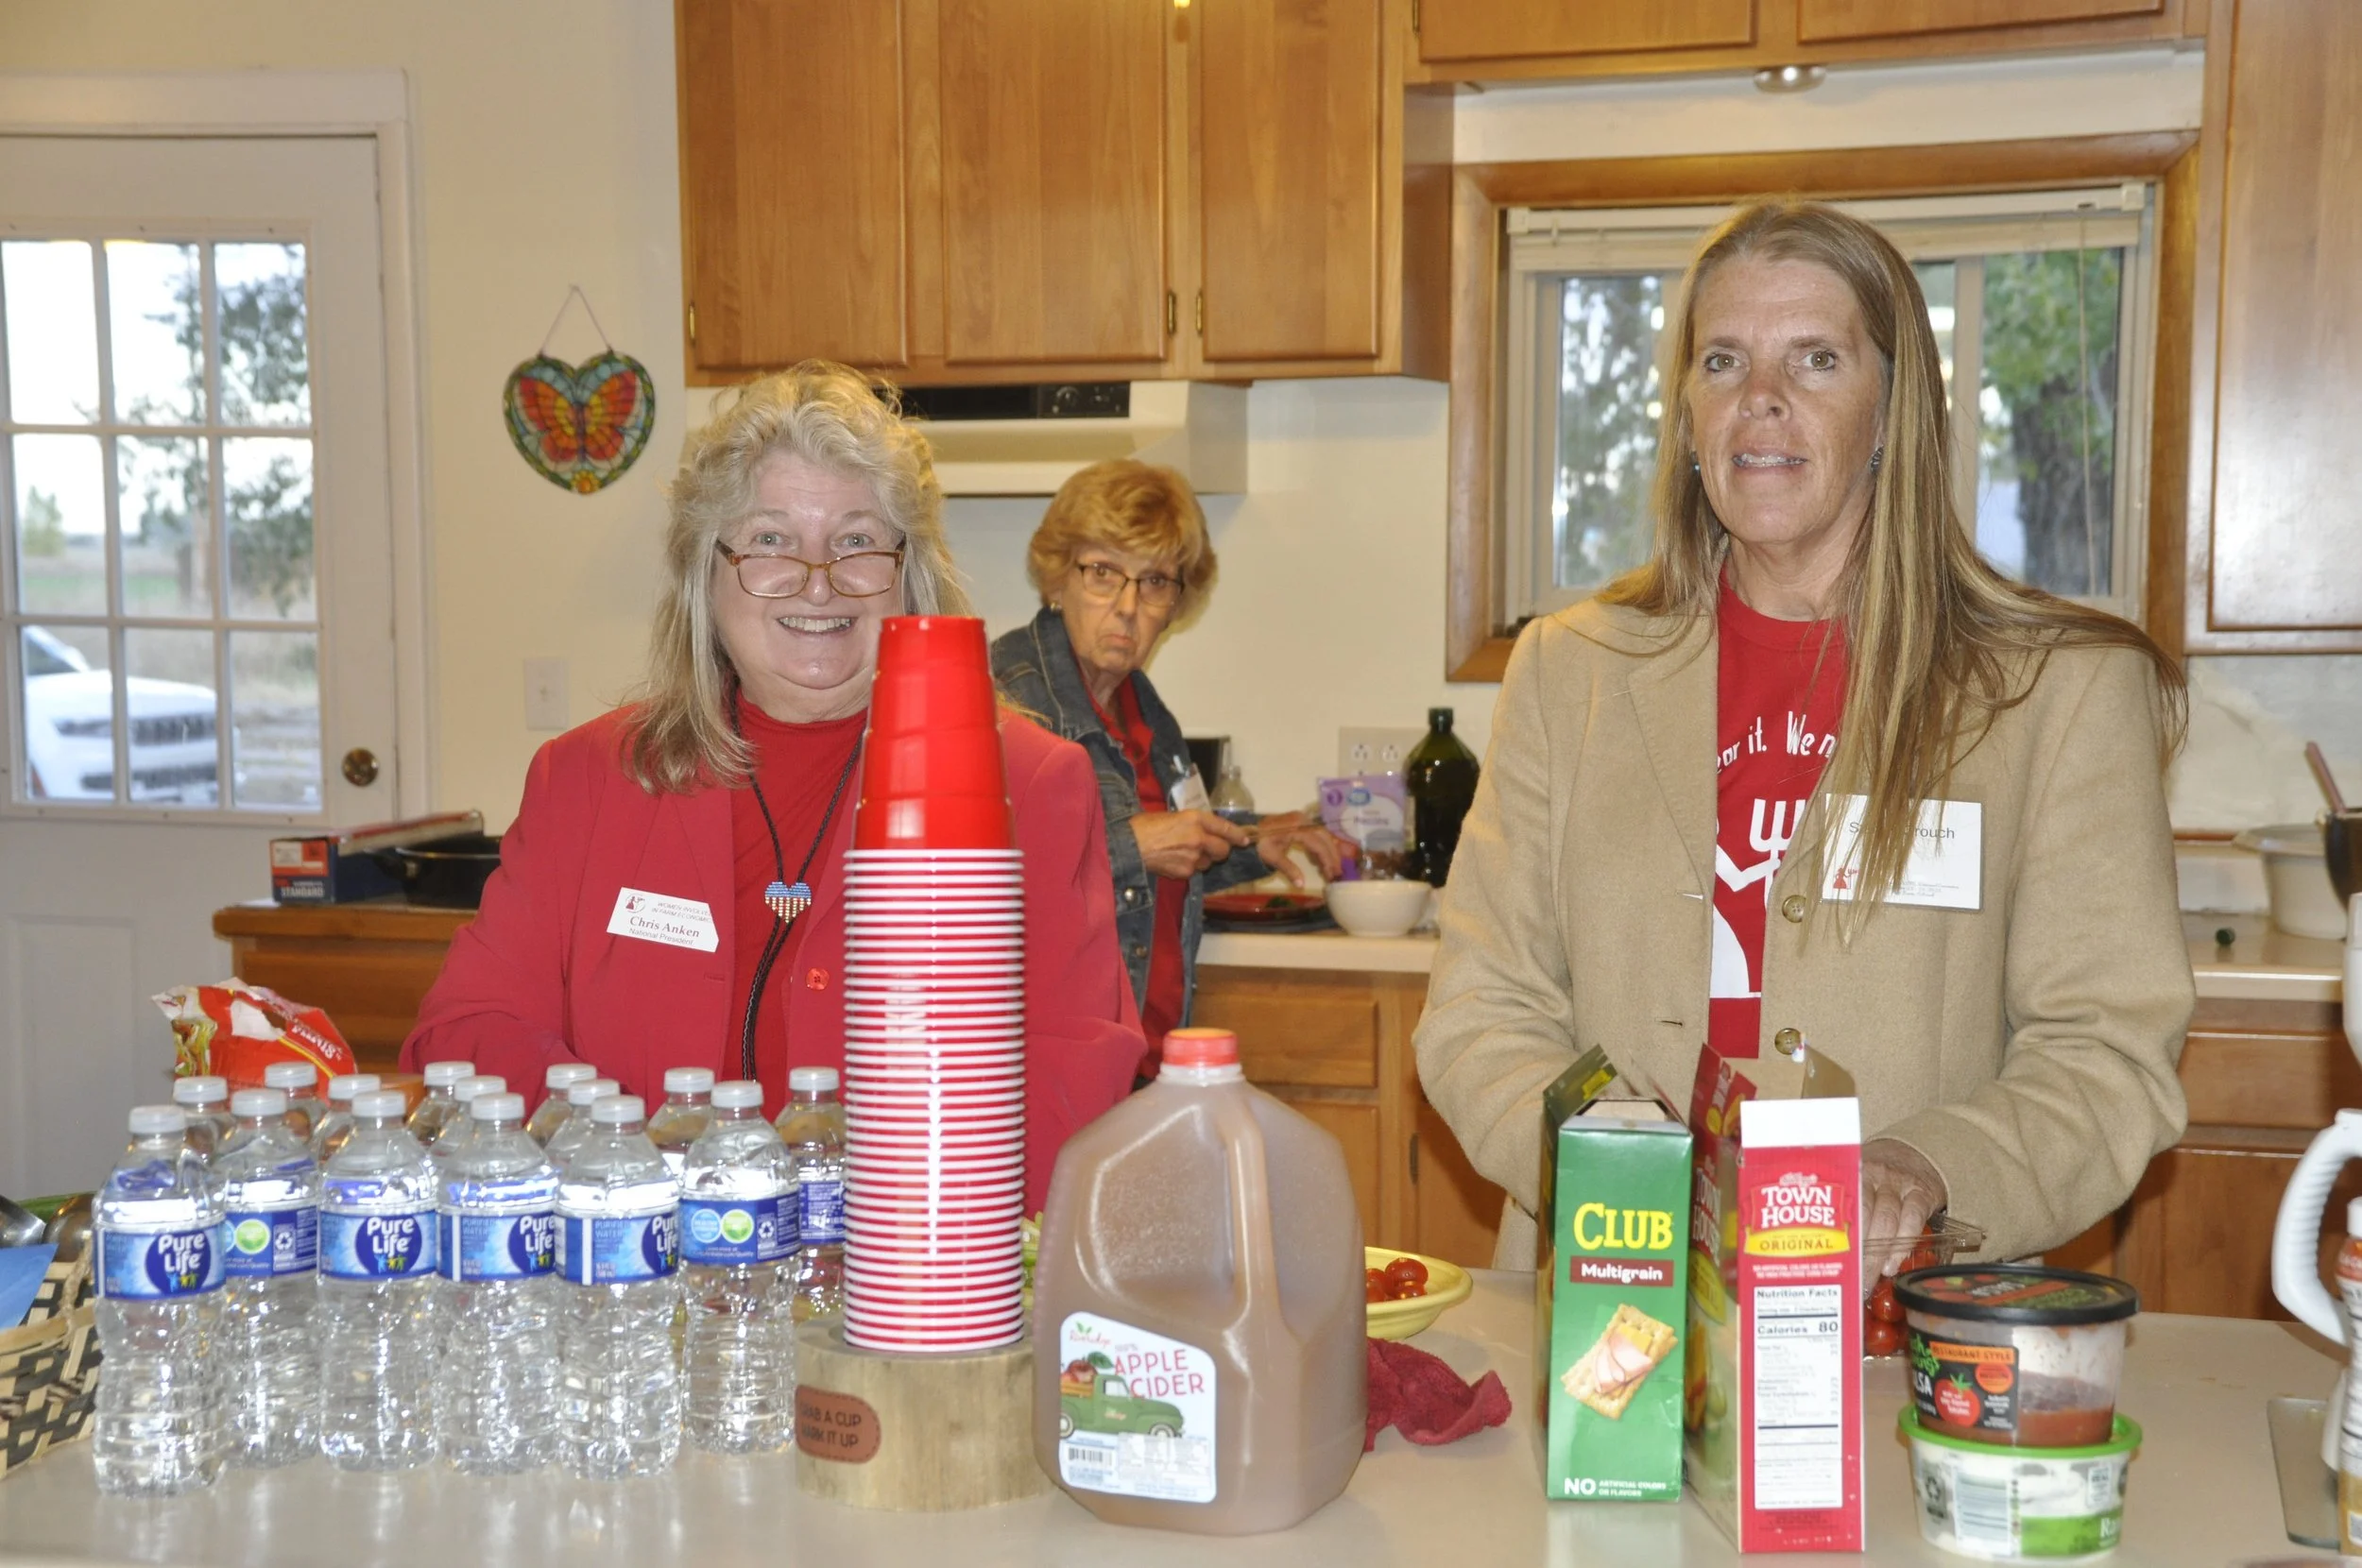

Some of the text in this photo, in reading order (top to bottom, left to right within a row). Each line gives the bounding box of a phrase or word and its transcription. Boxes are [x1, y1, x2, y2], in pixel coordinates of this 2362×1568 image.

[1748, 716, 1768, 755] it.
[1787, 710, 1815, 756] We
[1914, 826, 1955, 840] rouch
[629, 915, 700, 937] Chris Anken
[629, 928, 694, 946] National President
[1761, 1185, 1832, 1206] TOWN
[367, 1217, 415, 1236] Pure
[520, 1215, 556, 1235] Pure
[1573, 1202, 1673, 1251] CLUB
[1761, 1205, 1835, 1229] HOUSE
[158, 1233, 205, 1254] Pure
[372, 1234, 412, 1258] Life
[525, 1232, 554, 1255] Life
[1759, 1238, 1833, 1252] ORIGINAL
[163, 1251, 202, 1275] Life
[1581, 1262, 1663, 1284] Multigrain
[1756, 1287, 1838, 1299] Nutrition Facts
[1757, 1321, 1839, 1335] Calories 80
[1114, 1349, 1189, 1376] APPLE
[1130, 1372, 1205, 1399] CIDER
[824, 1410, 833, 1424] A
[835, 1410, 862, 1428] CUP
[827, 1430, 837, 1445] IT
[840, 1432, 859, 1448] UP
[1564, 1477, 1597, 1495] NO
[1637, 1481, 1667, 1491] COLORS
